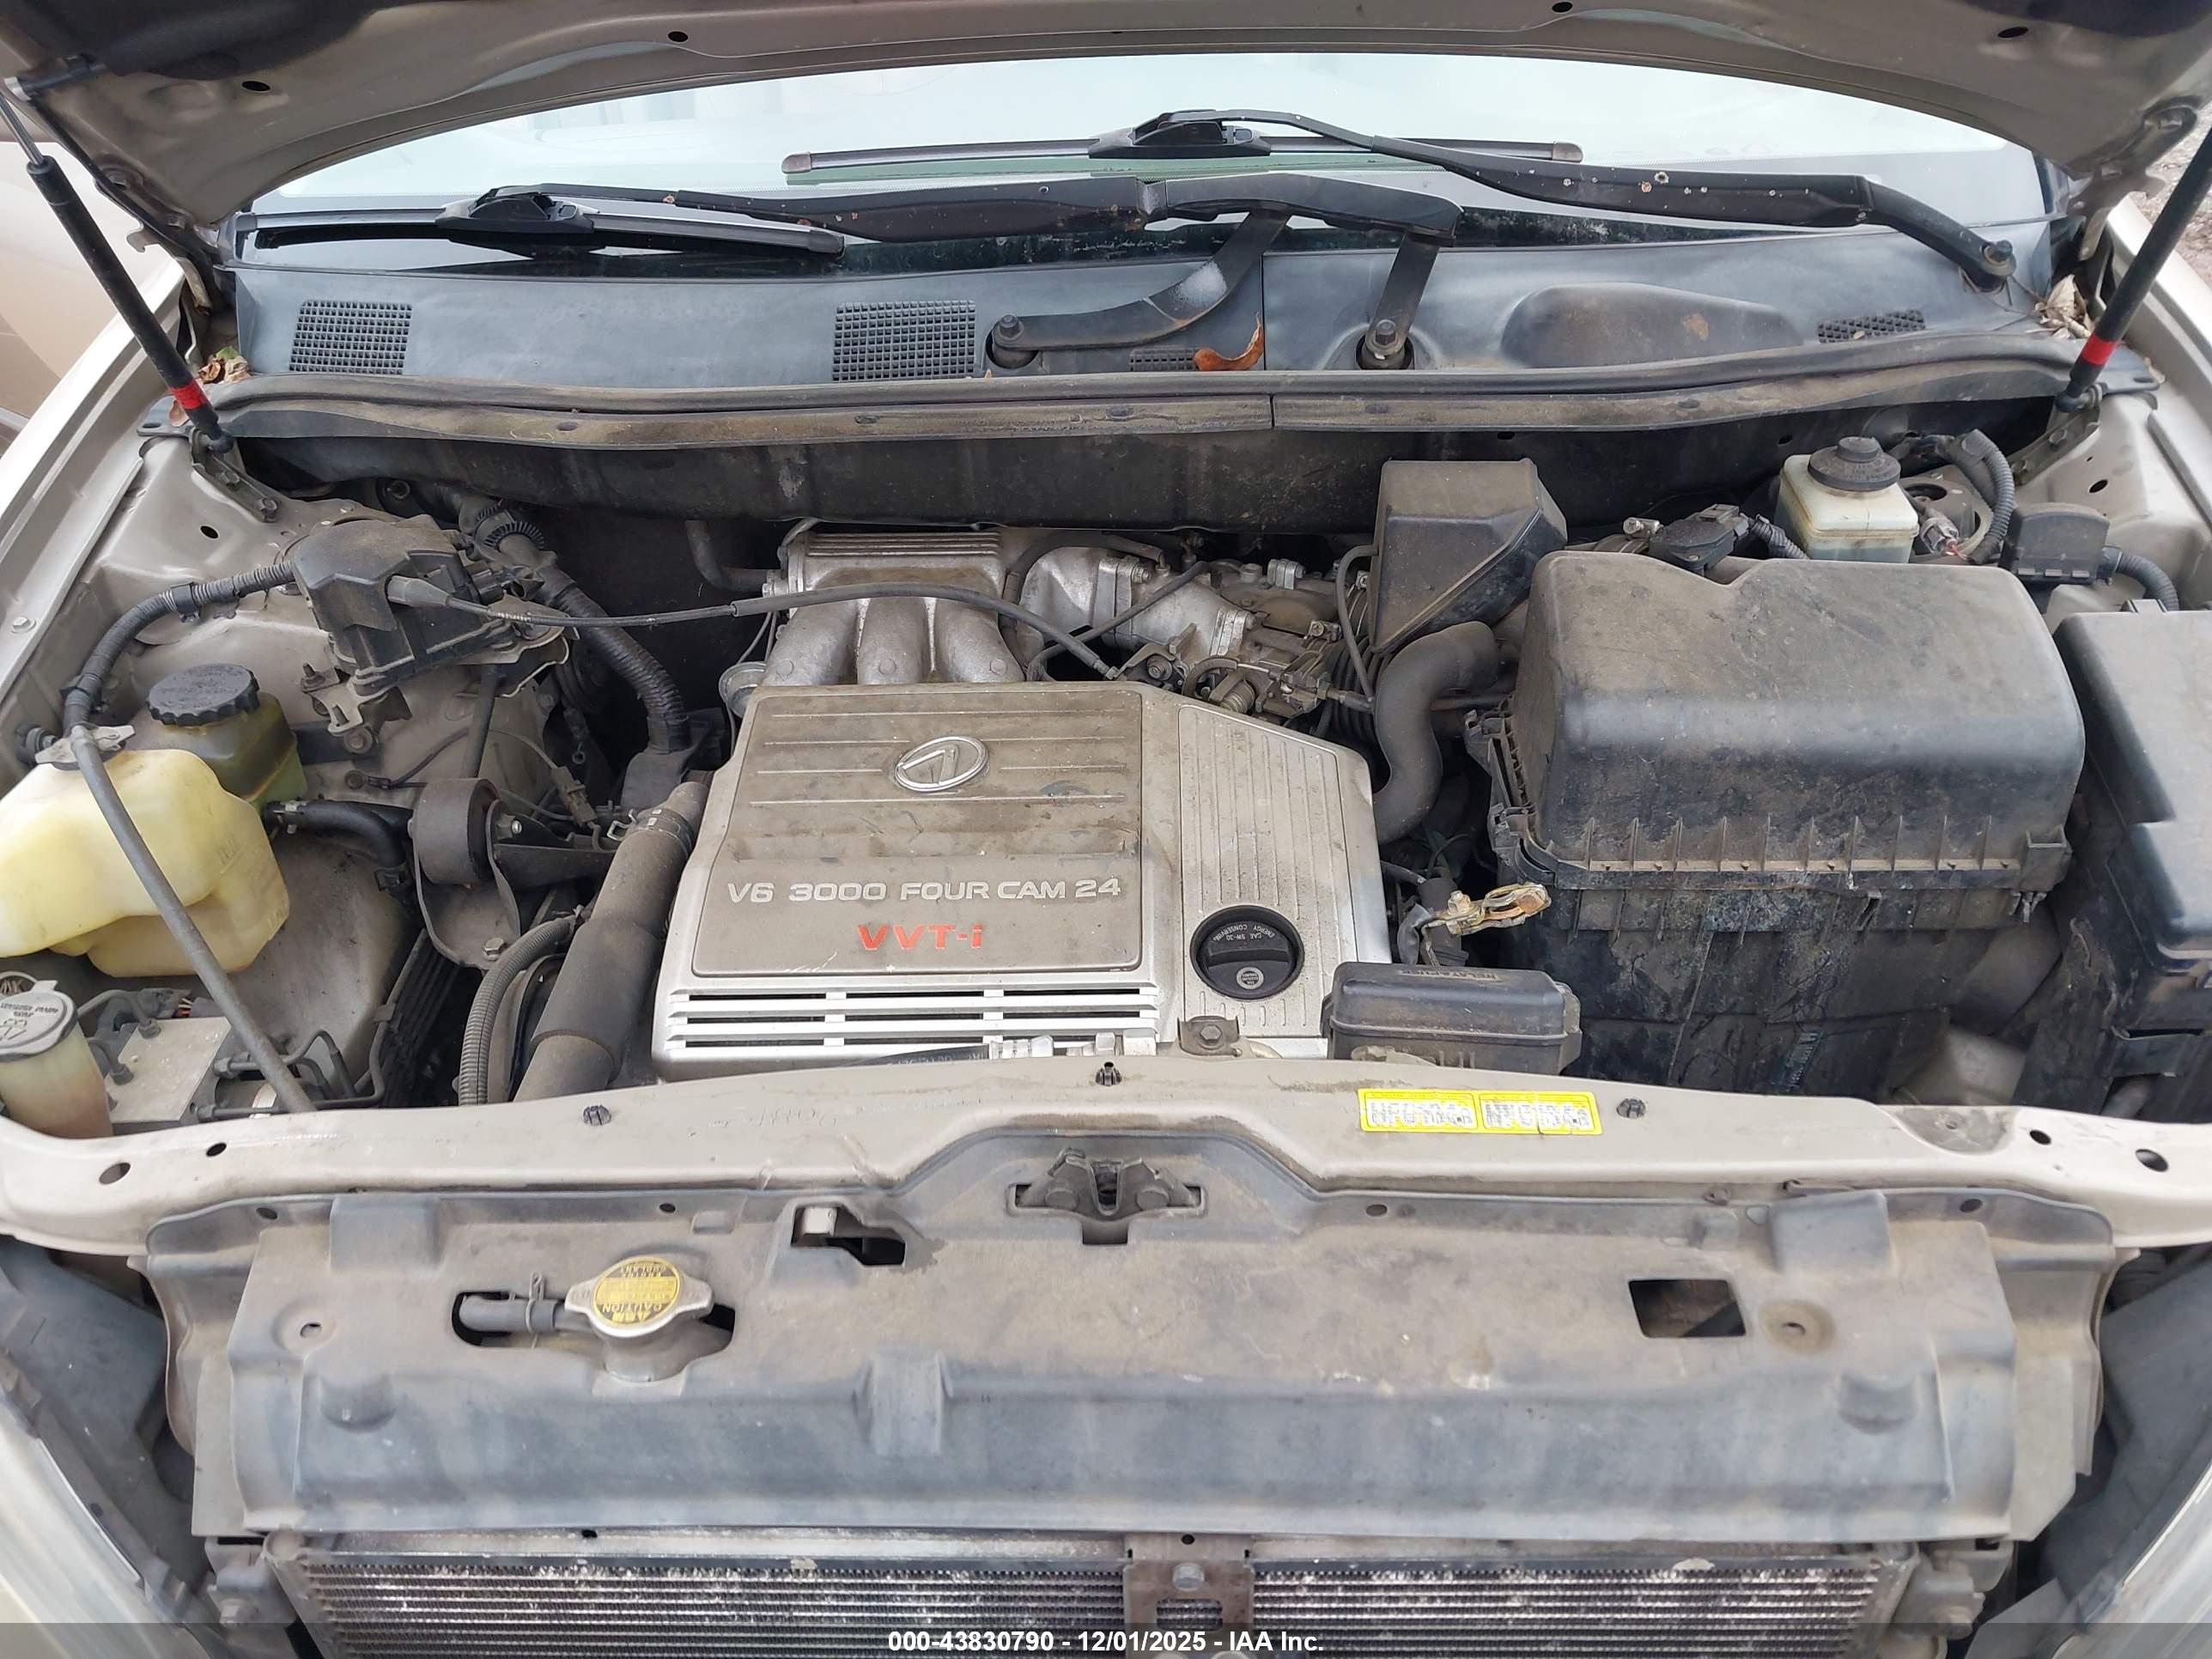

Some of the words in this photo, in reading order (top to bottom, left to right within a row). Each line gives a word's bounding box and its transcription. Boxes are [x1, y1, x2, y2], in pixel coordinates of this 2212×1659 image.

[727, 882, 775, 903] V6
[788, 882, 887, 902] 3000
[900, 881, 990, 901] FOUR
[997, 880, 1066, 900] CAM
[1074, 878, 1121, 899] 24
[857, 924, 983, 950] VVT-i
[602, 1304, 662, 1313] CAUTION
